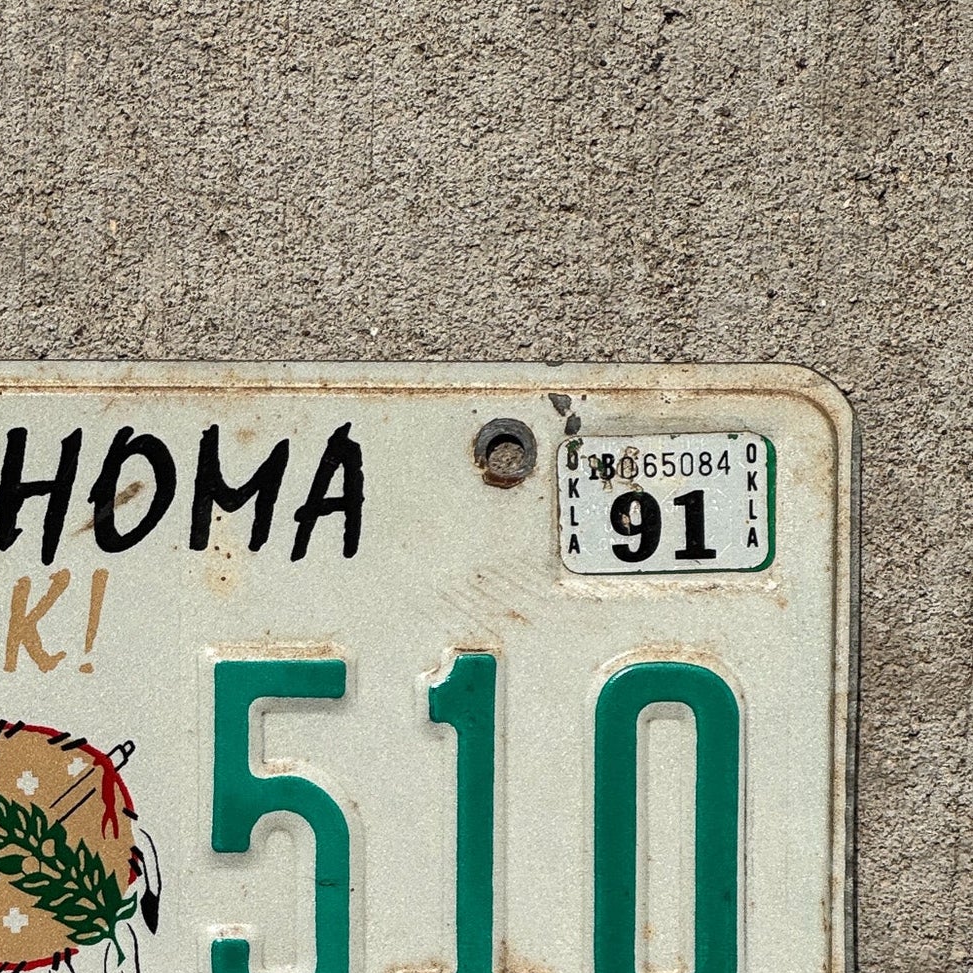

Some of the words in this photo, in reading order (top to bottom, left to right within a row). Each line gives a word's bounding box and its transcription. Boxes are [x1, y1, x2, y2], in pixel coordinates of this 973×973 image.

[567, 447, 581, 554] OKLA
[610, 490, 716, 562] 91
[746, 443, 759, 548] OKLA
